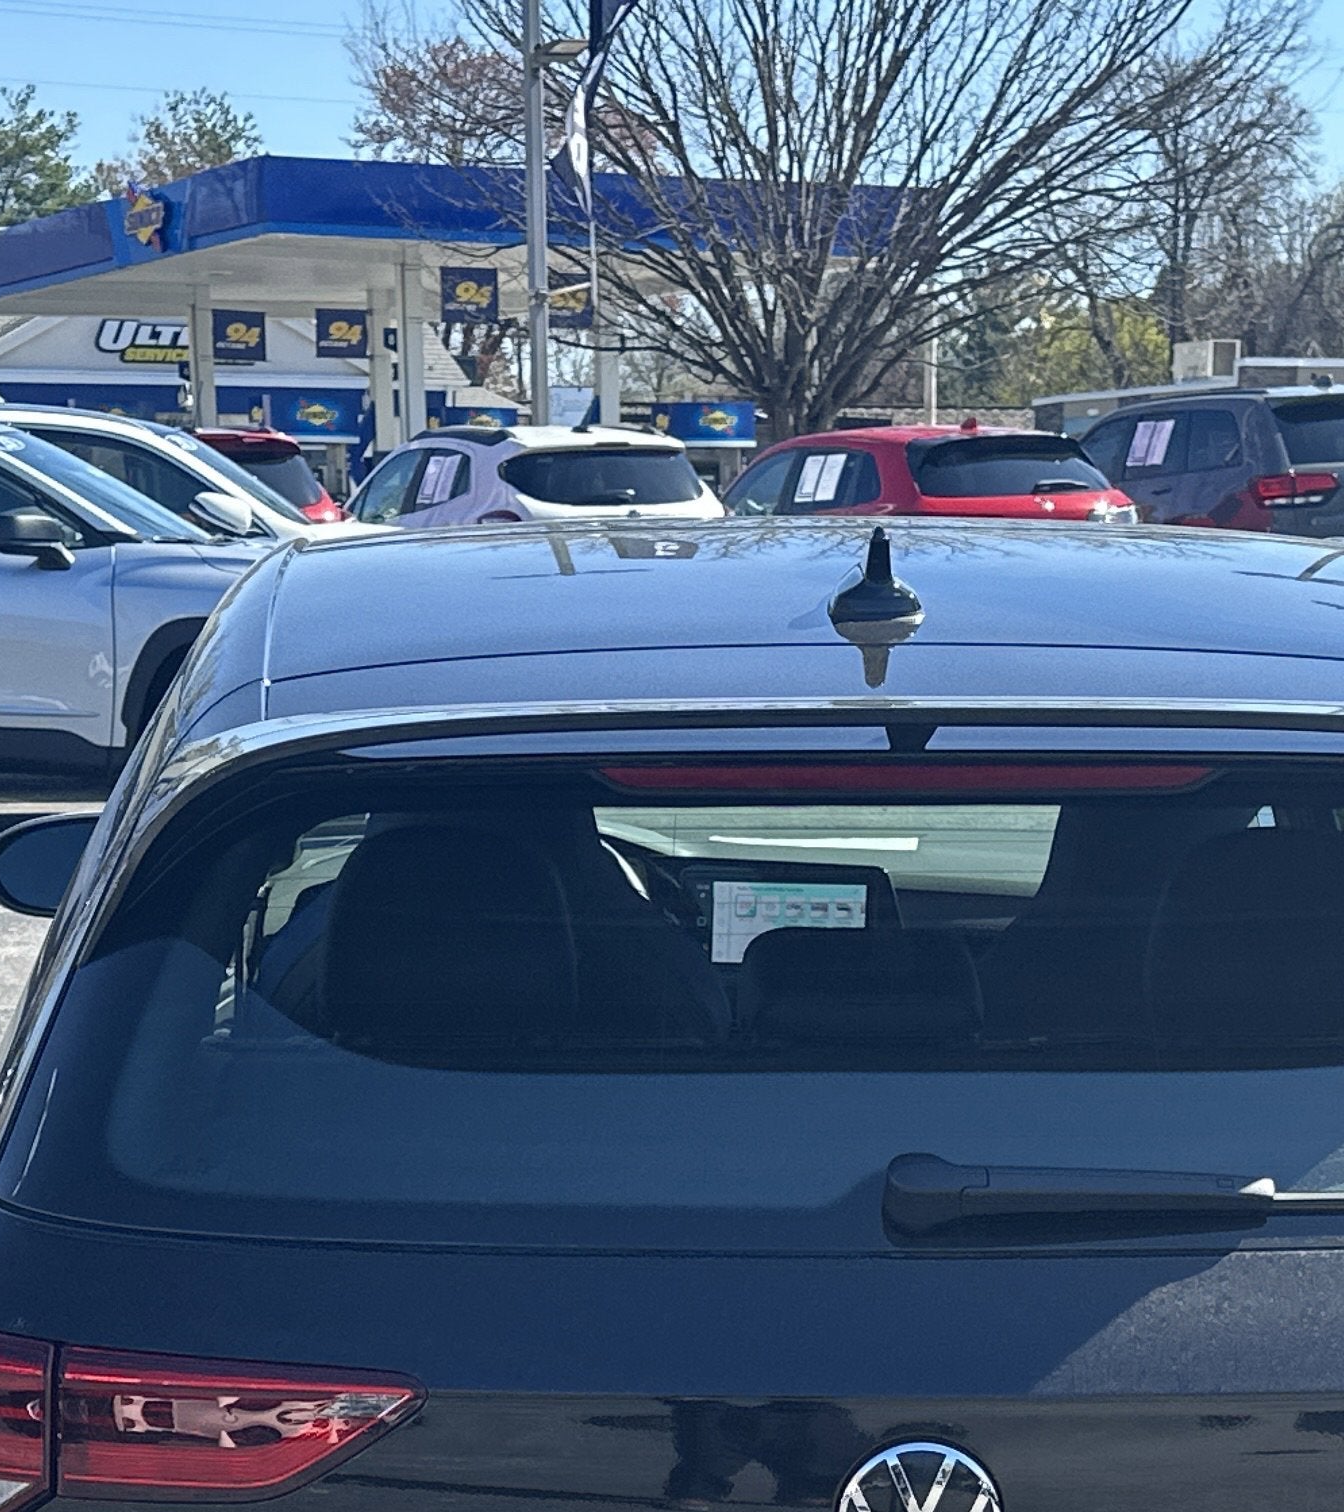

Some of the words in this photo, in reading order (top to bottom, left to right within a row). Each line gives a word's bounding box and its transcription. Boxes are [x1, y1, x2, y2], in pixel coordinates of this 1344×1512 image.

[455, 281, 493, 308] 94
[225, 321, 261, 347] 94
[328, 321, 363, 345] 94
